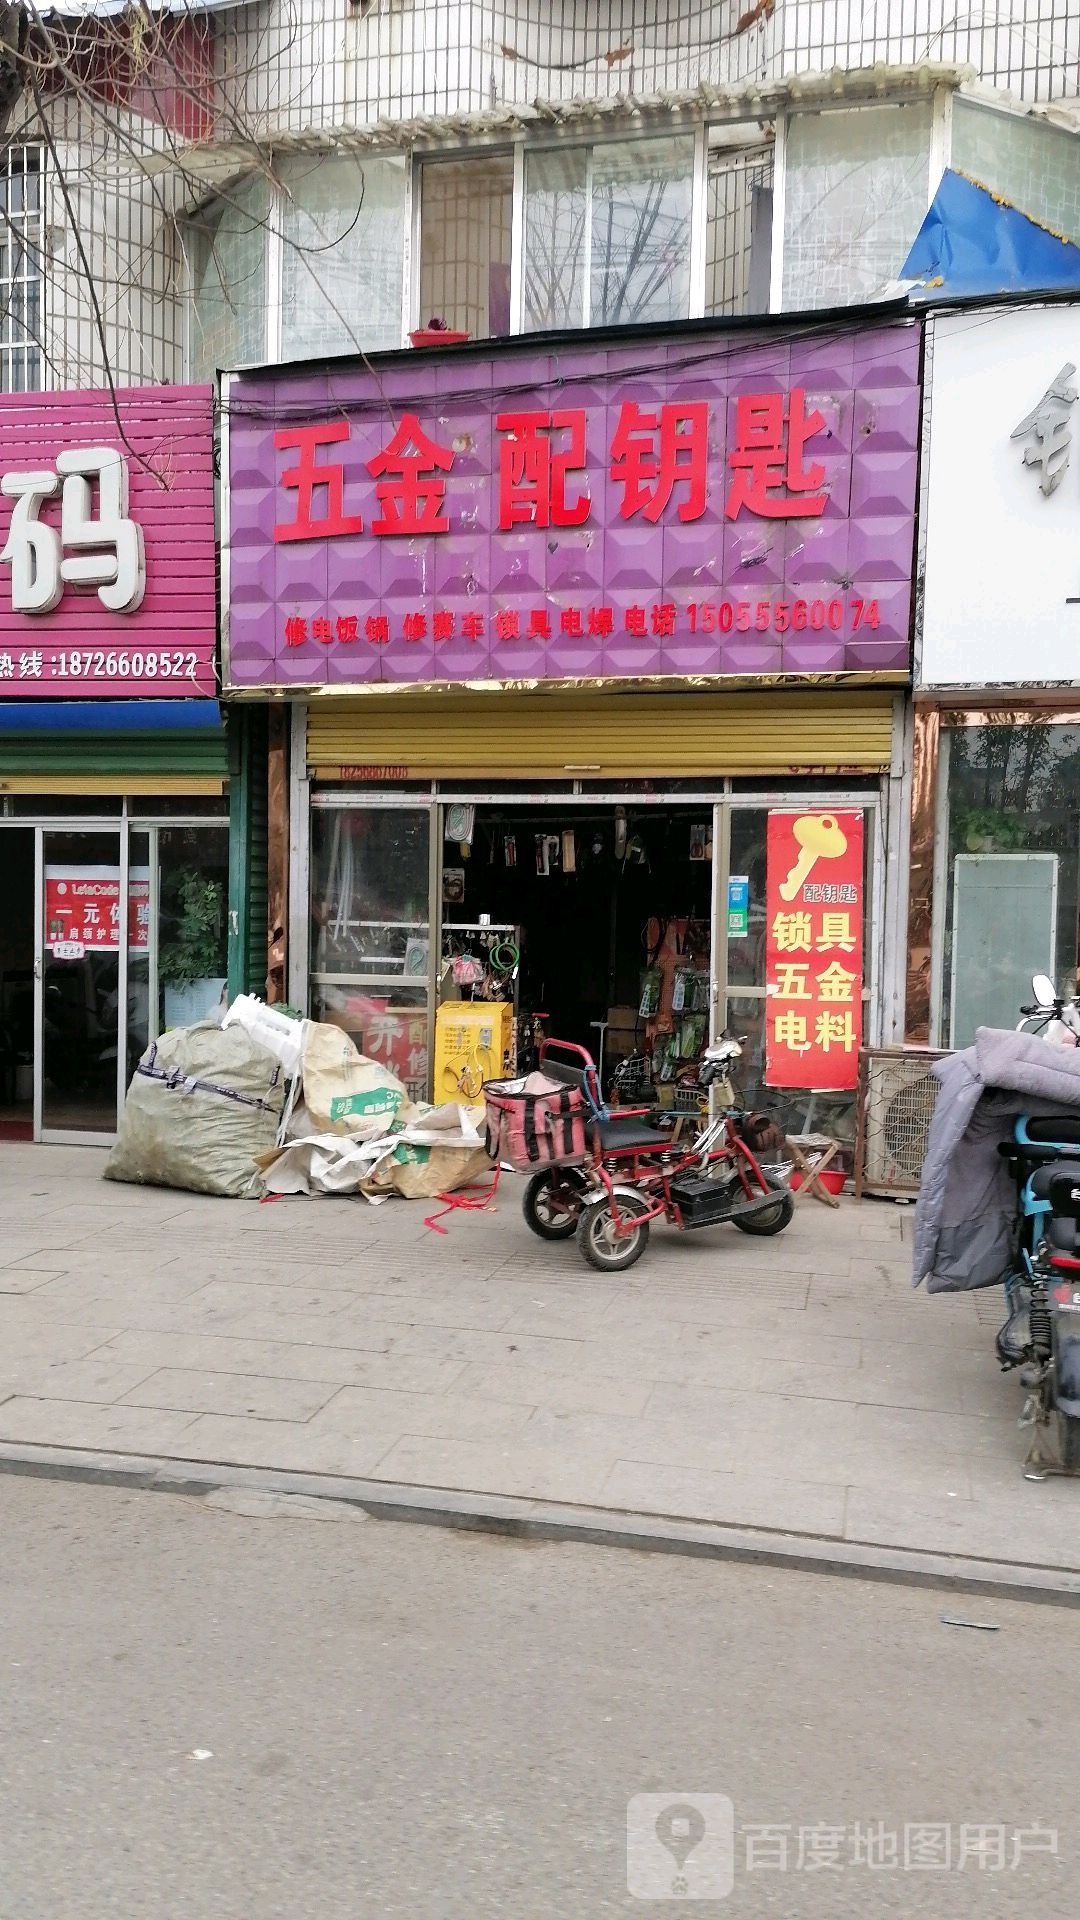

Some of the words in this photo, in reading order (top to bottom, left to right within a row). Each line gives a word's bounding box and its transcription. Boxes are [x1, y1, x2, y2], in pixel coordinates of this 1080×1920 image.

[273, 414, 456, 543] 五金
[496, 388, 827, 529] 配钥匙
[0, 446, 146, 614] 码
[285, 615, 391, 646] 修电饭锅
[495, 608, 551, 640] 锁具
[624, 603, 677, 636] 电话
[686, 599, 880, 633] 15055560074
[803, 884, 857, 903] 配钥匙
[772, 911, 857, 953] 锁具
[772, 961, 857, 1002] 五金
[774, 1010, 857, 1053] 电料
